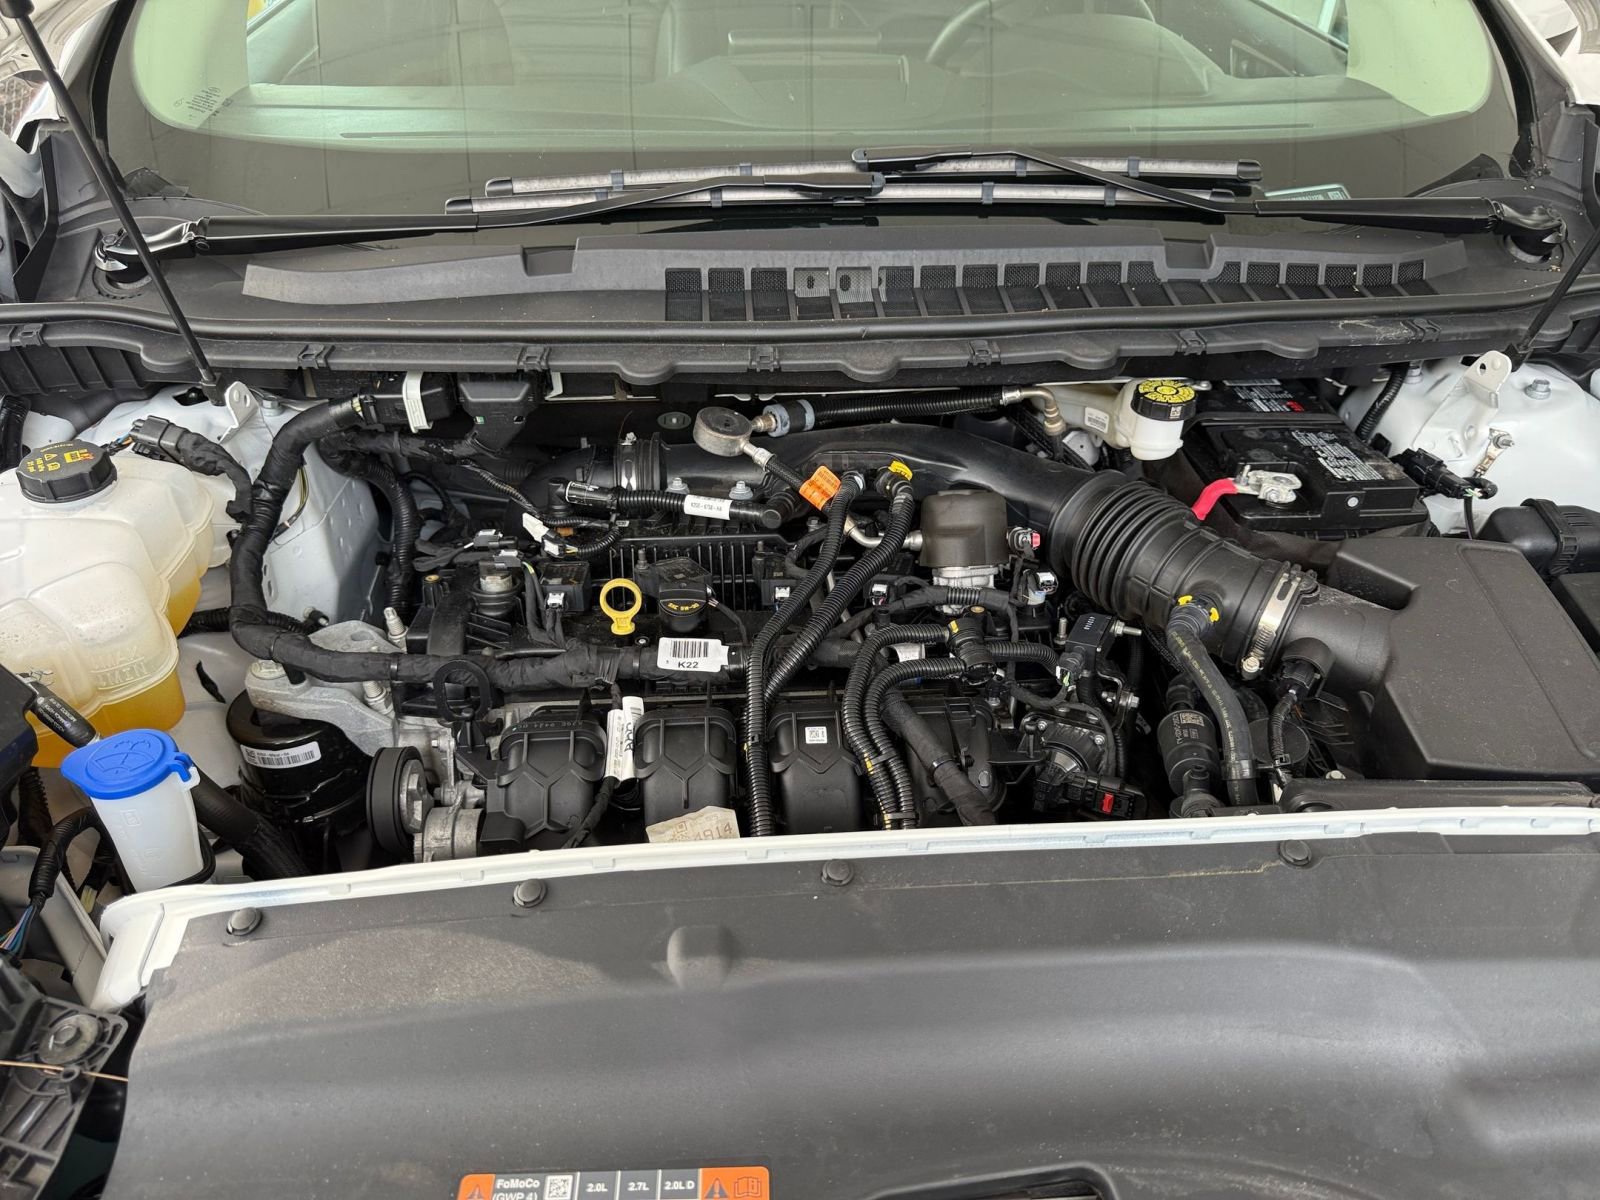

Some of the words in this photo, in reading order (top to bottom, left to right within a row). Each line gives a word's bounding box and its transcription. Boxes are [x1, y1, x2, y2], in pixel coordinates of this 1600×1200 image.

[678, 661, 699, 669] K22
[496, 1178, 541, 1190] FoMoCo
[586, 1182, 609, 1192] 2.0L
[627, 1181, 650, 1191] 2.7L
[663, 1180, 686, 1190] 2.0L
[686, 1180, 696, 1190] D
